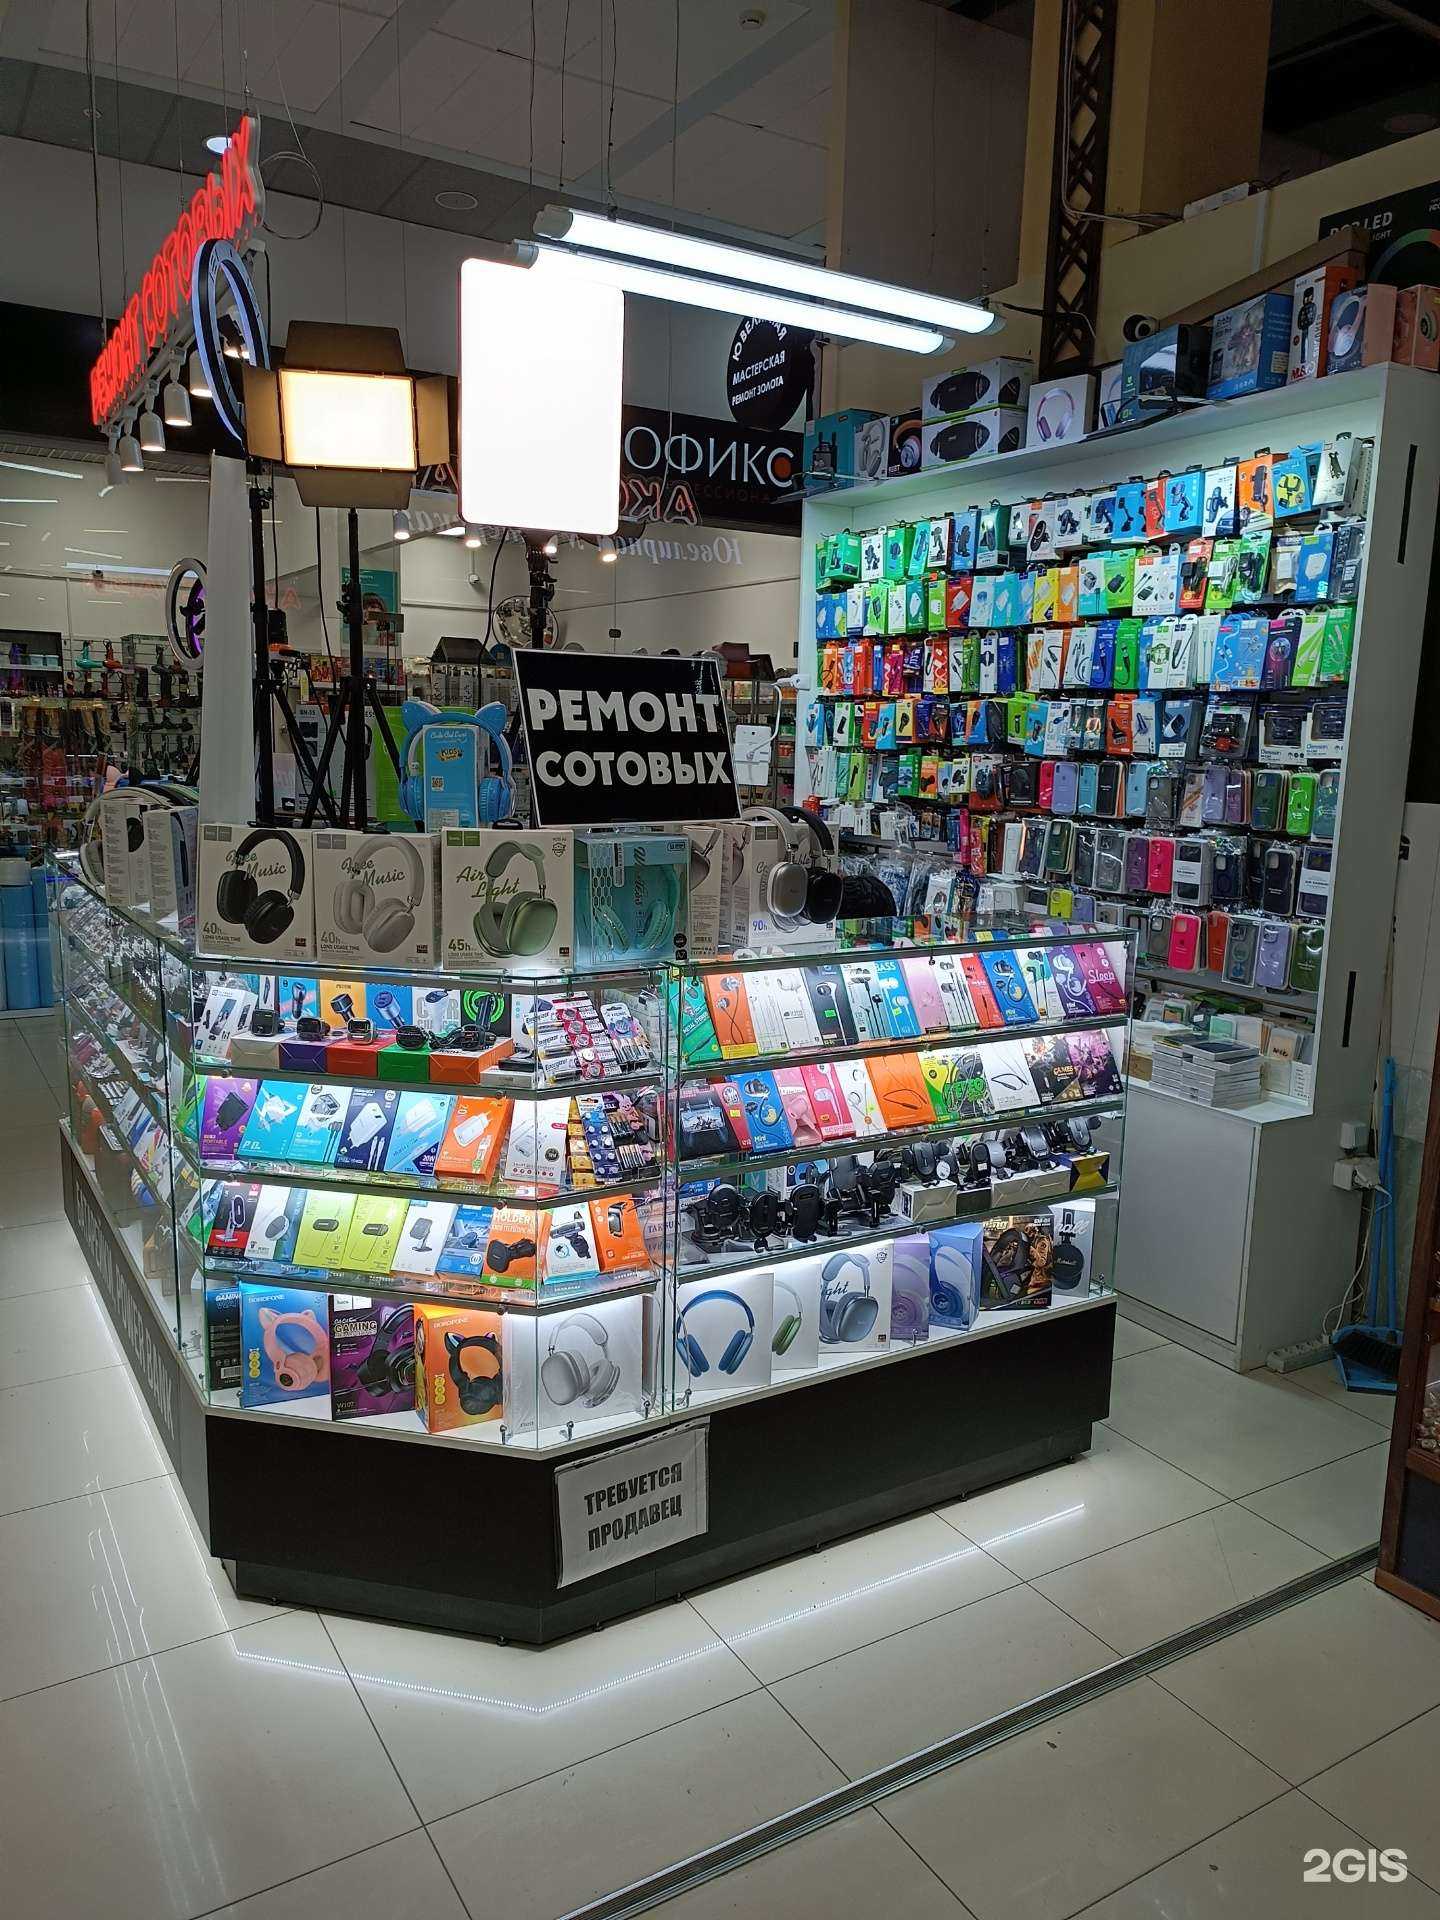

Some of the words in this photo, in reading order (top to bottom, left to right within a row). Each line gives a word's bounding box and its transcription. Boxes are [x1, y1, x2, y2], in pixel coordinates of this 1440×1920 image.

[732, 350, 786, 386] МАСТЕРСКАЯ
[731, 387, 756, 407] РЕМОНТ
[756, 375, 784, 396] ЗОЛОТА
[526, 688, 719, 733] РЕМОНТ
[535, 750, 732, 787] СОТОВЫХ
[243, 862, 287, 881] Music
[360, 869, 405, 887] Music
[456, 865, 486, 884] Air
[471, 878, 520, 901] Light
[875, 961, 897, 972] BASS
[1088, 969, 1115, 985] Sleep
[335, 1320, 378, 1333] GAMING
[583, 1462, 682, 1516] ТРЕБУЕТСЯ
[587, 1494, 683, 1552] ПРОДАВЕЦ
